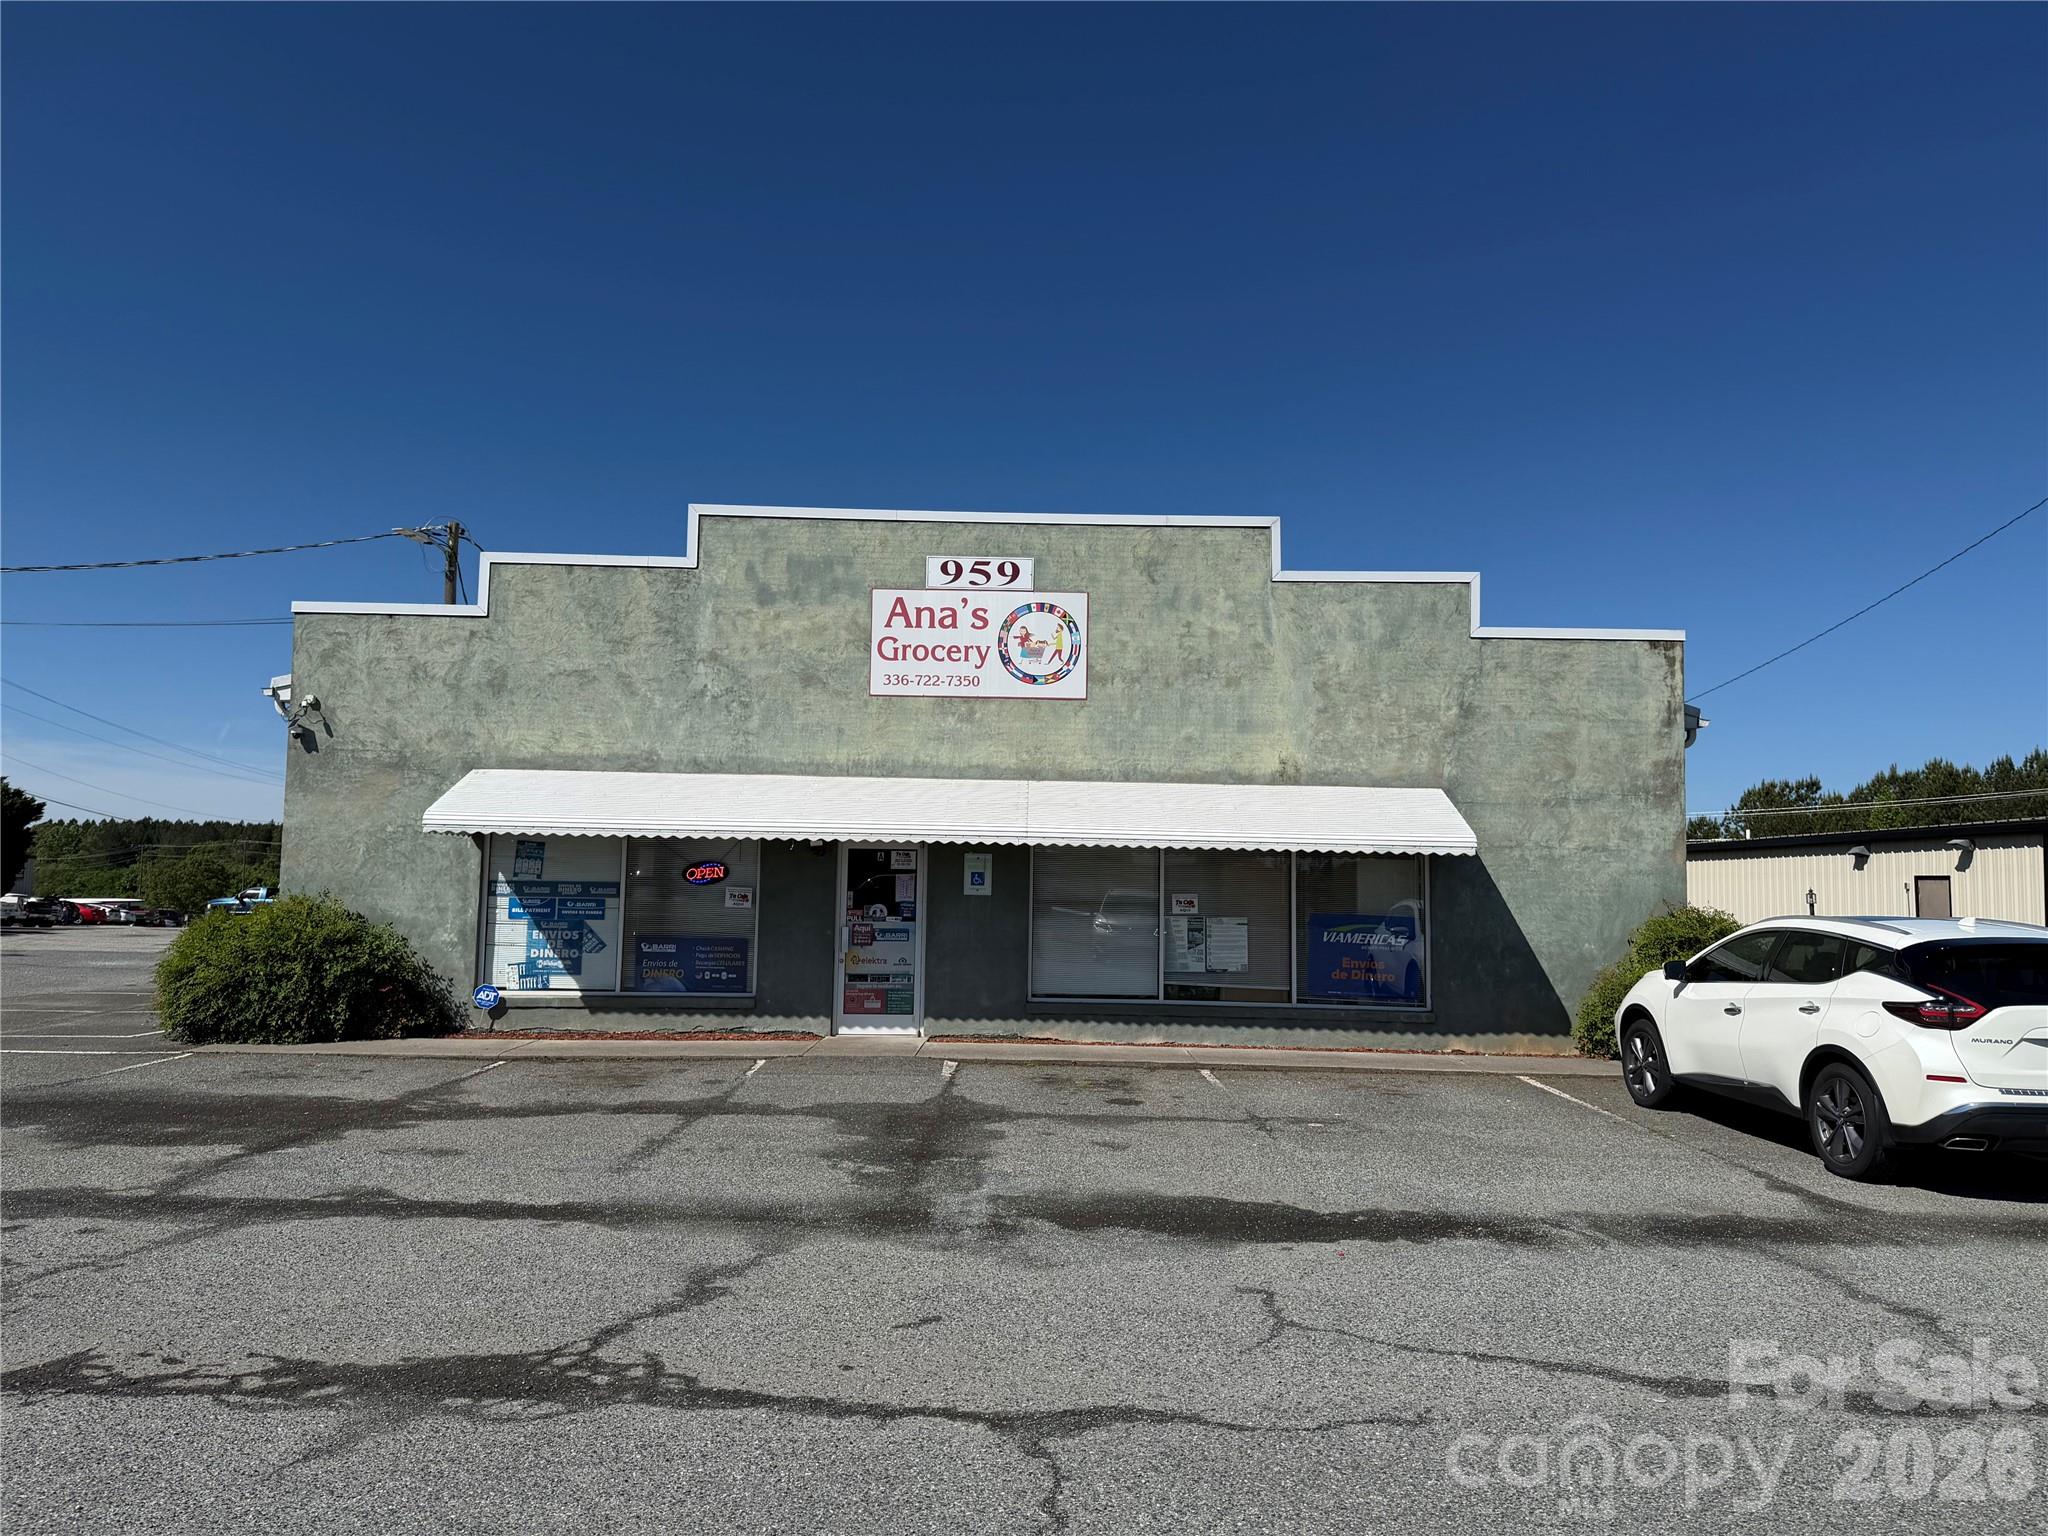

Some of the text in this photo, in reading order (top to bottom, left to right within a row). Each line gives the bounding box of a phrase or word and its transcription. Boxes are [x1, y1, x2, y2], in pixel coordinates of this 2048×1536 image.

[940, 559, 1020, 586] 959
[884, 596, 989, 630] Ana's
[877, 636, 991, 670] Grocery
[883, 674, 980, 687] 336-722-7350
[686, 866, 725, 880] OPEN
[532, 930, 579, 940] ENVIOS
[1322, 931, 1409, 946] VIAMERICAS
[547, 940, 563, 948] DE
[530, 949, 579, 958] DINERO
[668, 959, 678, 967] de
[860, 956, 887, 965] elektra
[642, 969, 684, 978] DINERO
[1331, 969, 1395, 981] de Dinero
[476, 990, 498, 1001] ADT
